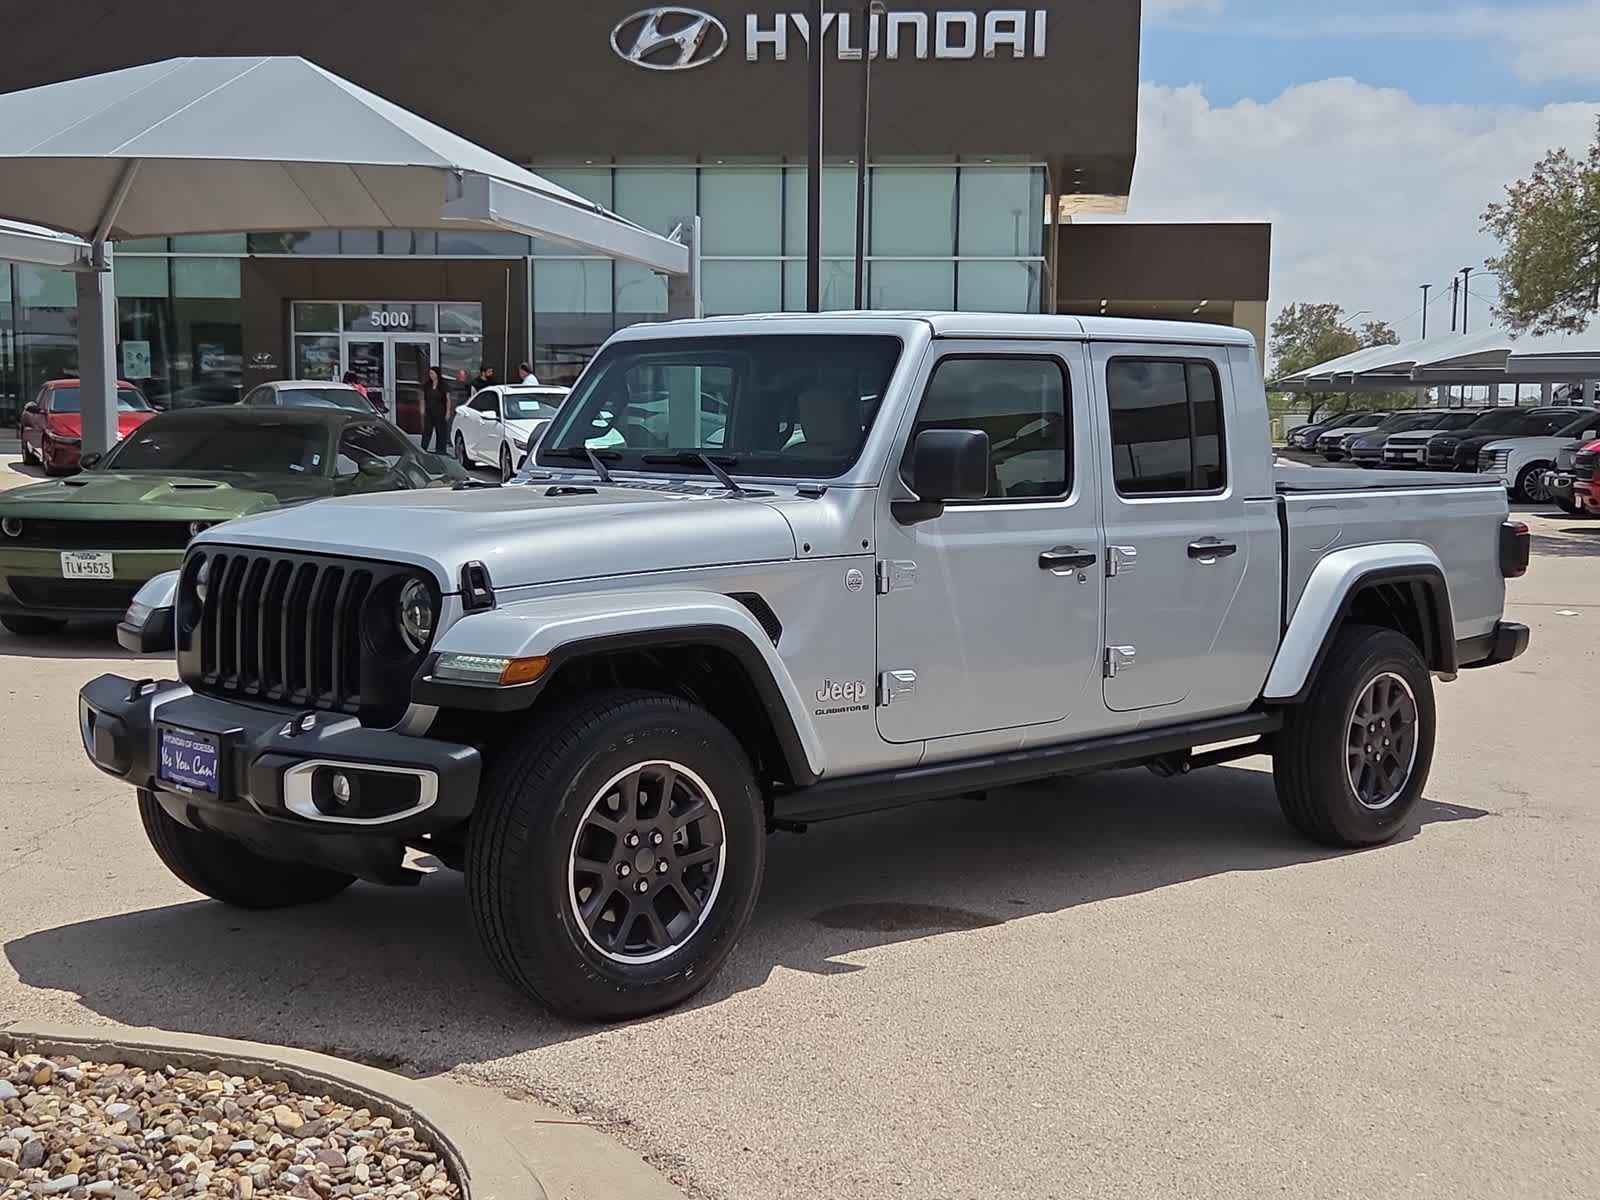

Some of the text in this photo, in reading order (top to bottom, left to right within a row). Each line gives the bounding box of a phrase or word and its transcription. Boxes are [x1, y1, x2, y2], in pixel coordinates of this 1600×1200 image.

[746, 10, 1047, 61] HYUNDAI
[370, 311, 409, 327] 5000
[815, 679, 866, 703] Jeep
[161, 746, 173, 768] Yes
[175, 750, 190, 770] You
[192, 755, 217, 779] Can!
